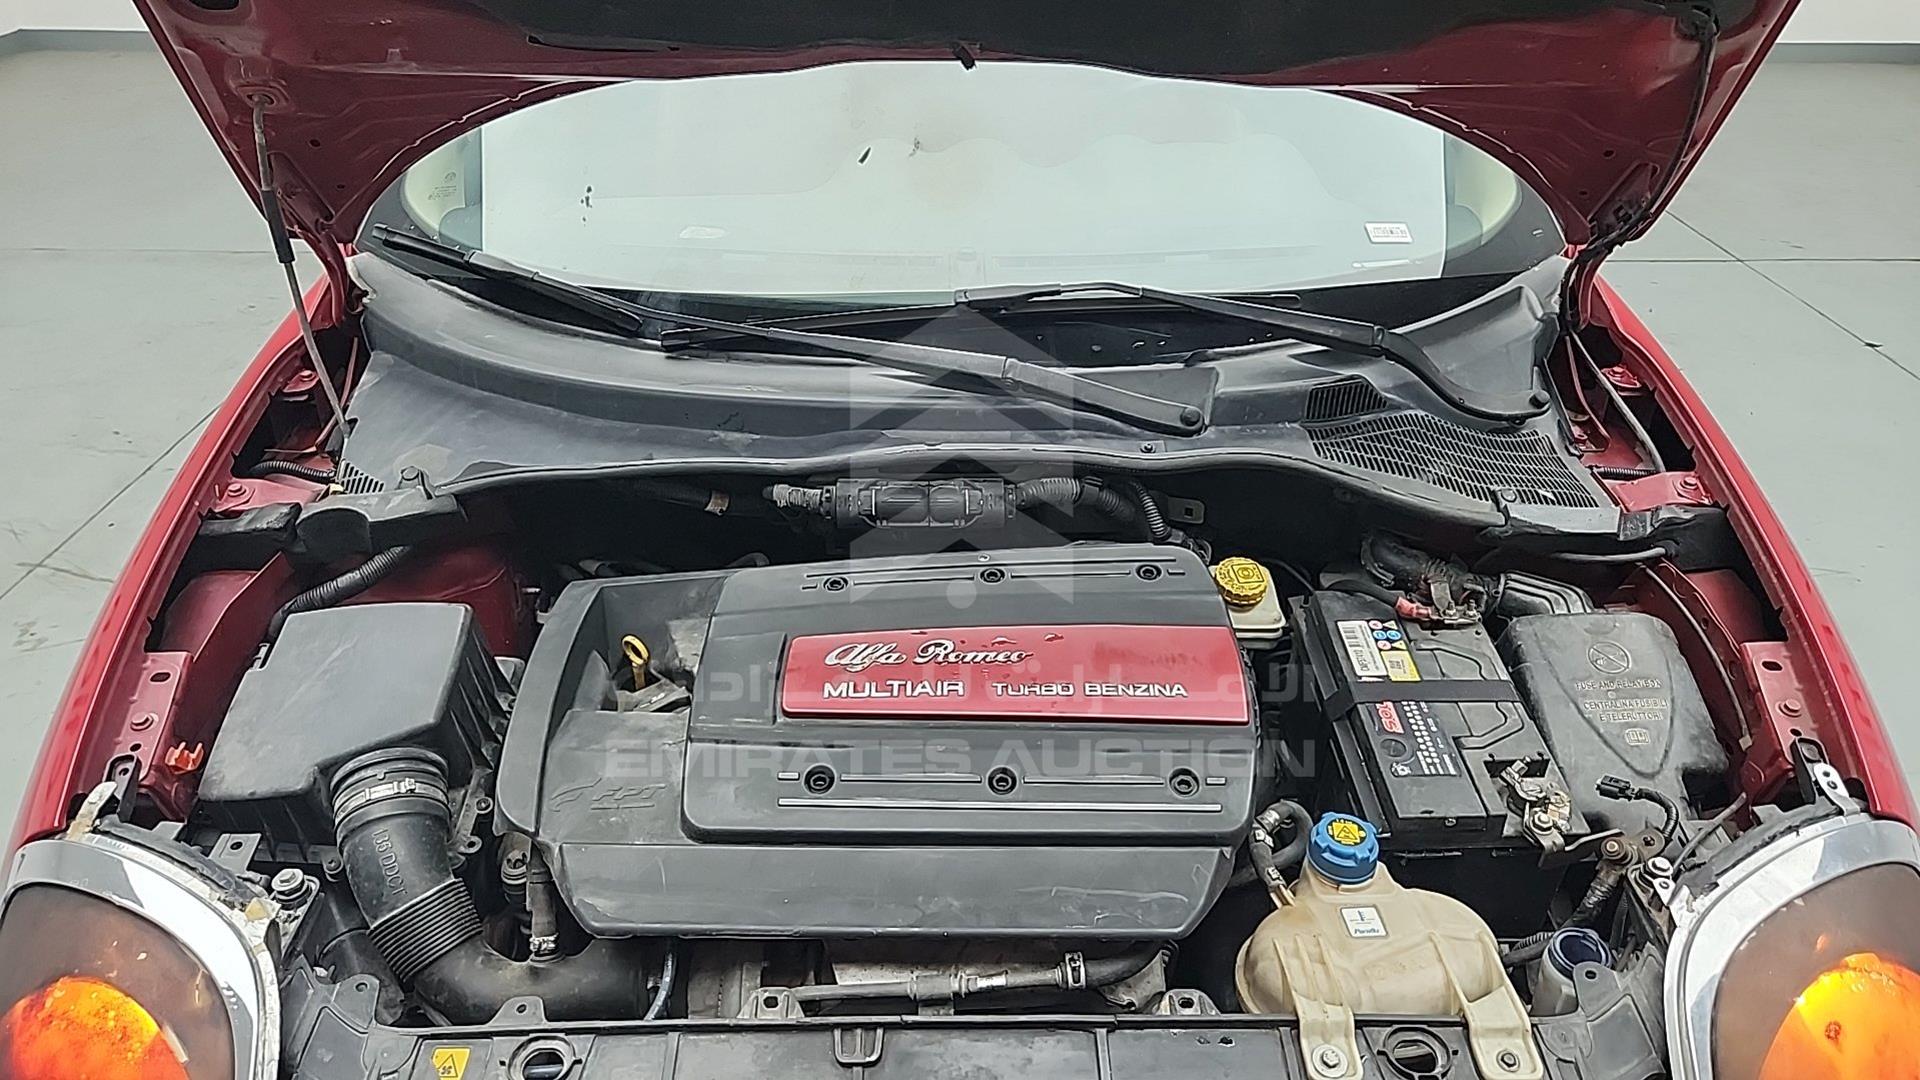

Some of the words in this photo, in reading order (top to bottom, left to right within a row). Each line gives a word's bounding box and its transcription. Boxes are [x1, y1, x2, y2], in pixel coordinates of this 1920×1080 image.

[824, 642, 907, 673] Alfa
[913, 638, 1034, 666] Romeo
[823, 679, 965, 698] MULTIAIR
[992, 682, 1055, 697] TURBO
[1083, 682, 1189, 698] BENZINA
[1576, 679, 1597, 691] FUSE
